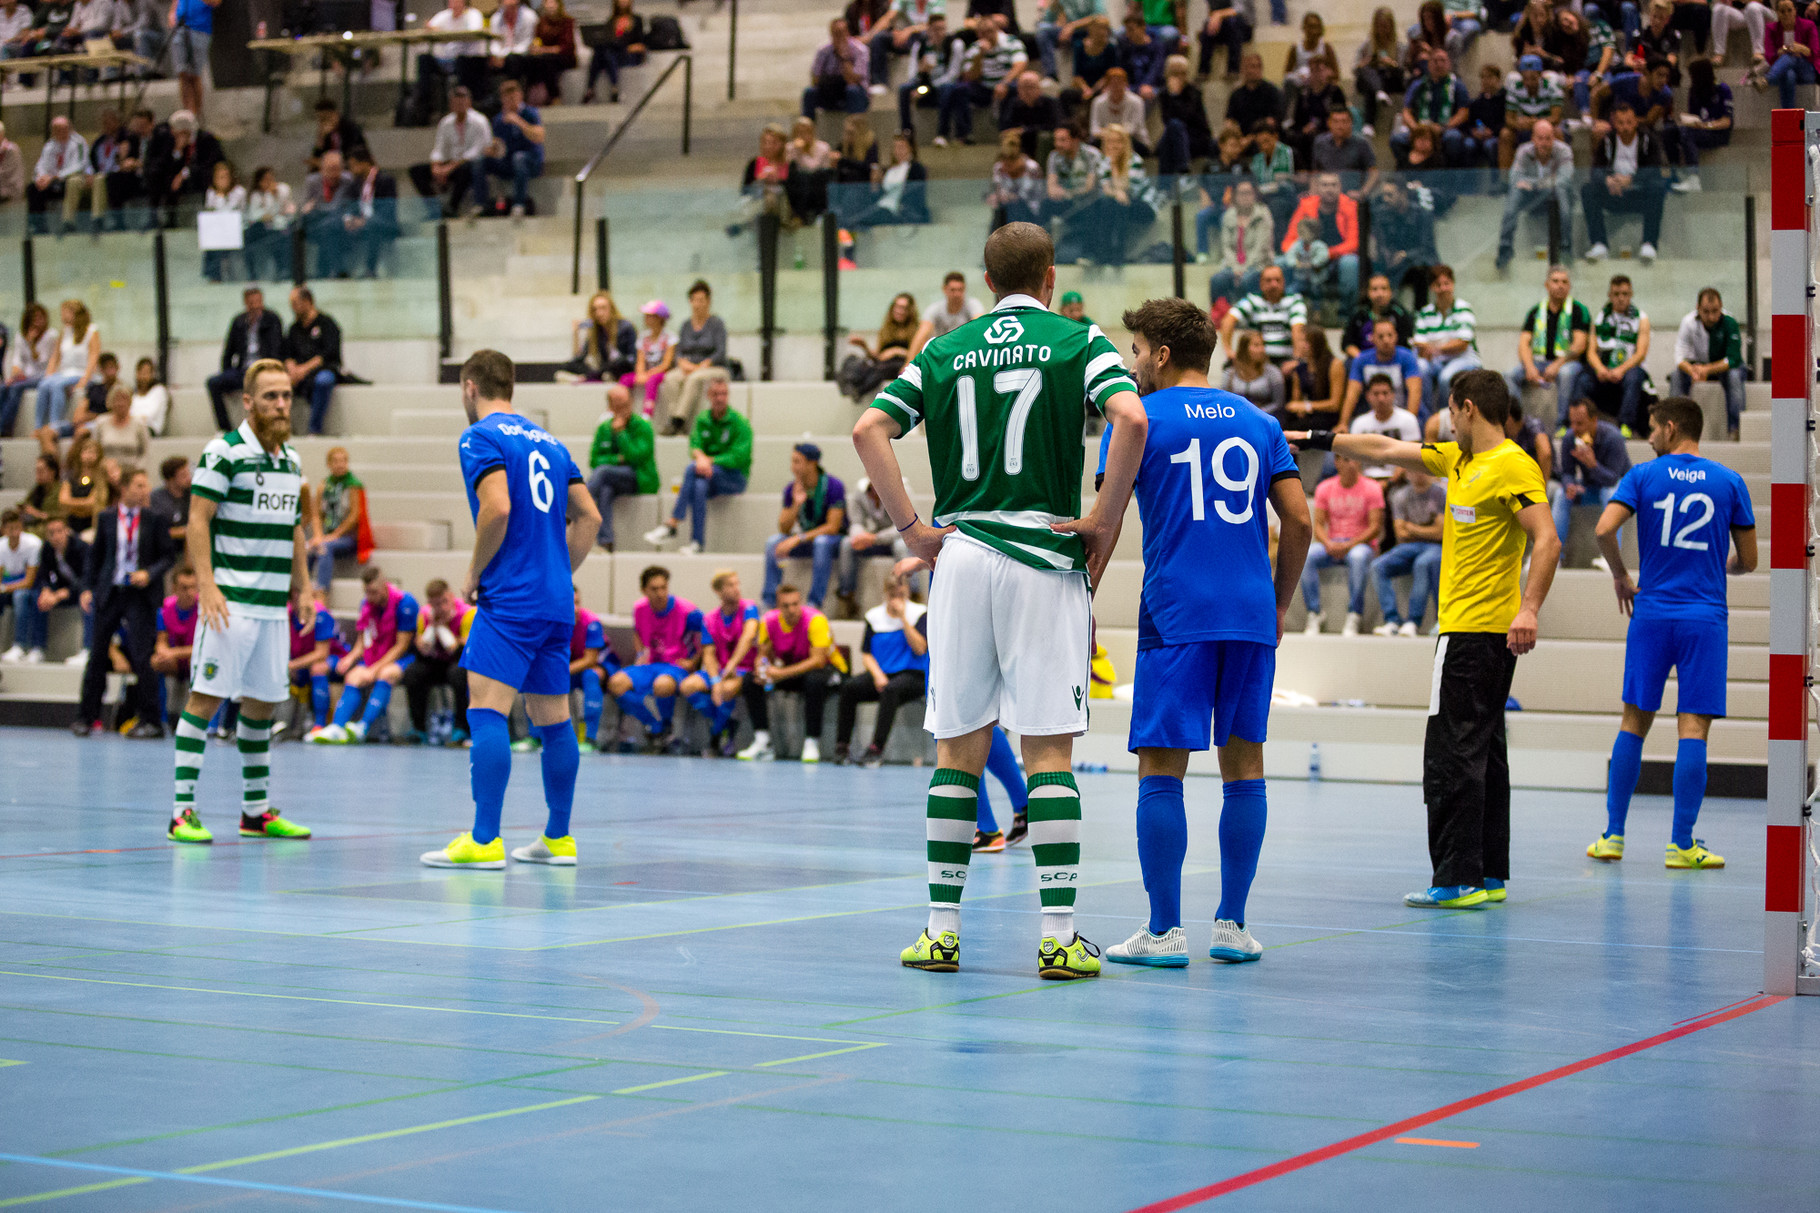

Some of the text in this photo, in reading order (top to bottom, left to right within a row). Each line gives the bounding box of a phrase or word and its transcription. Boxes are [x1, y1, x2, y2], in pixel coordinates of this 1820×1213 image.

[953, 344, 1051, 371] CAVINATO
[956, 367, 1043, 482] 17
[1184, 403, 1236, 419] Melo
[528, 449, 554, 514] 6
[1170, 436, 1259, 525] 19
[1668, 466, 1706, 484] Veiga
[258, 493, 296, 511] ROFF
[1653, 492, 1715, 551] 12
[941, 870, 967, 880] SC
